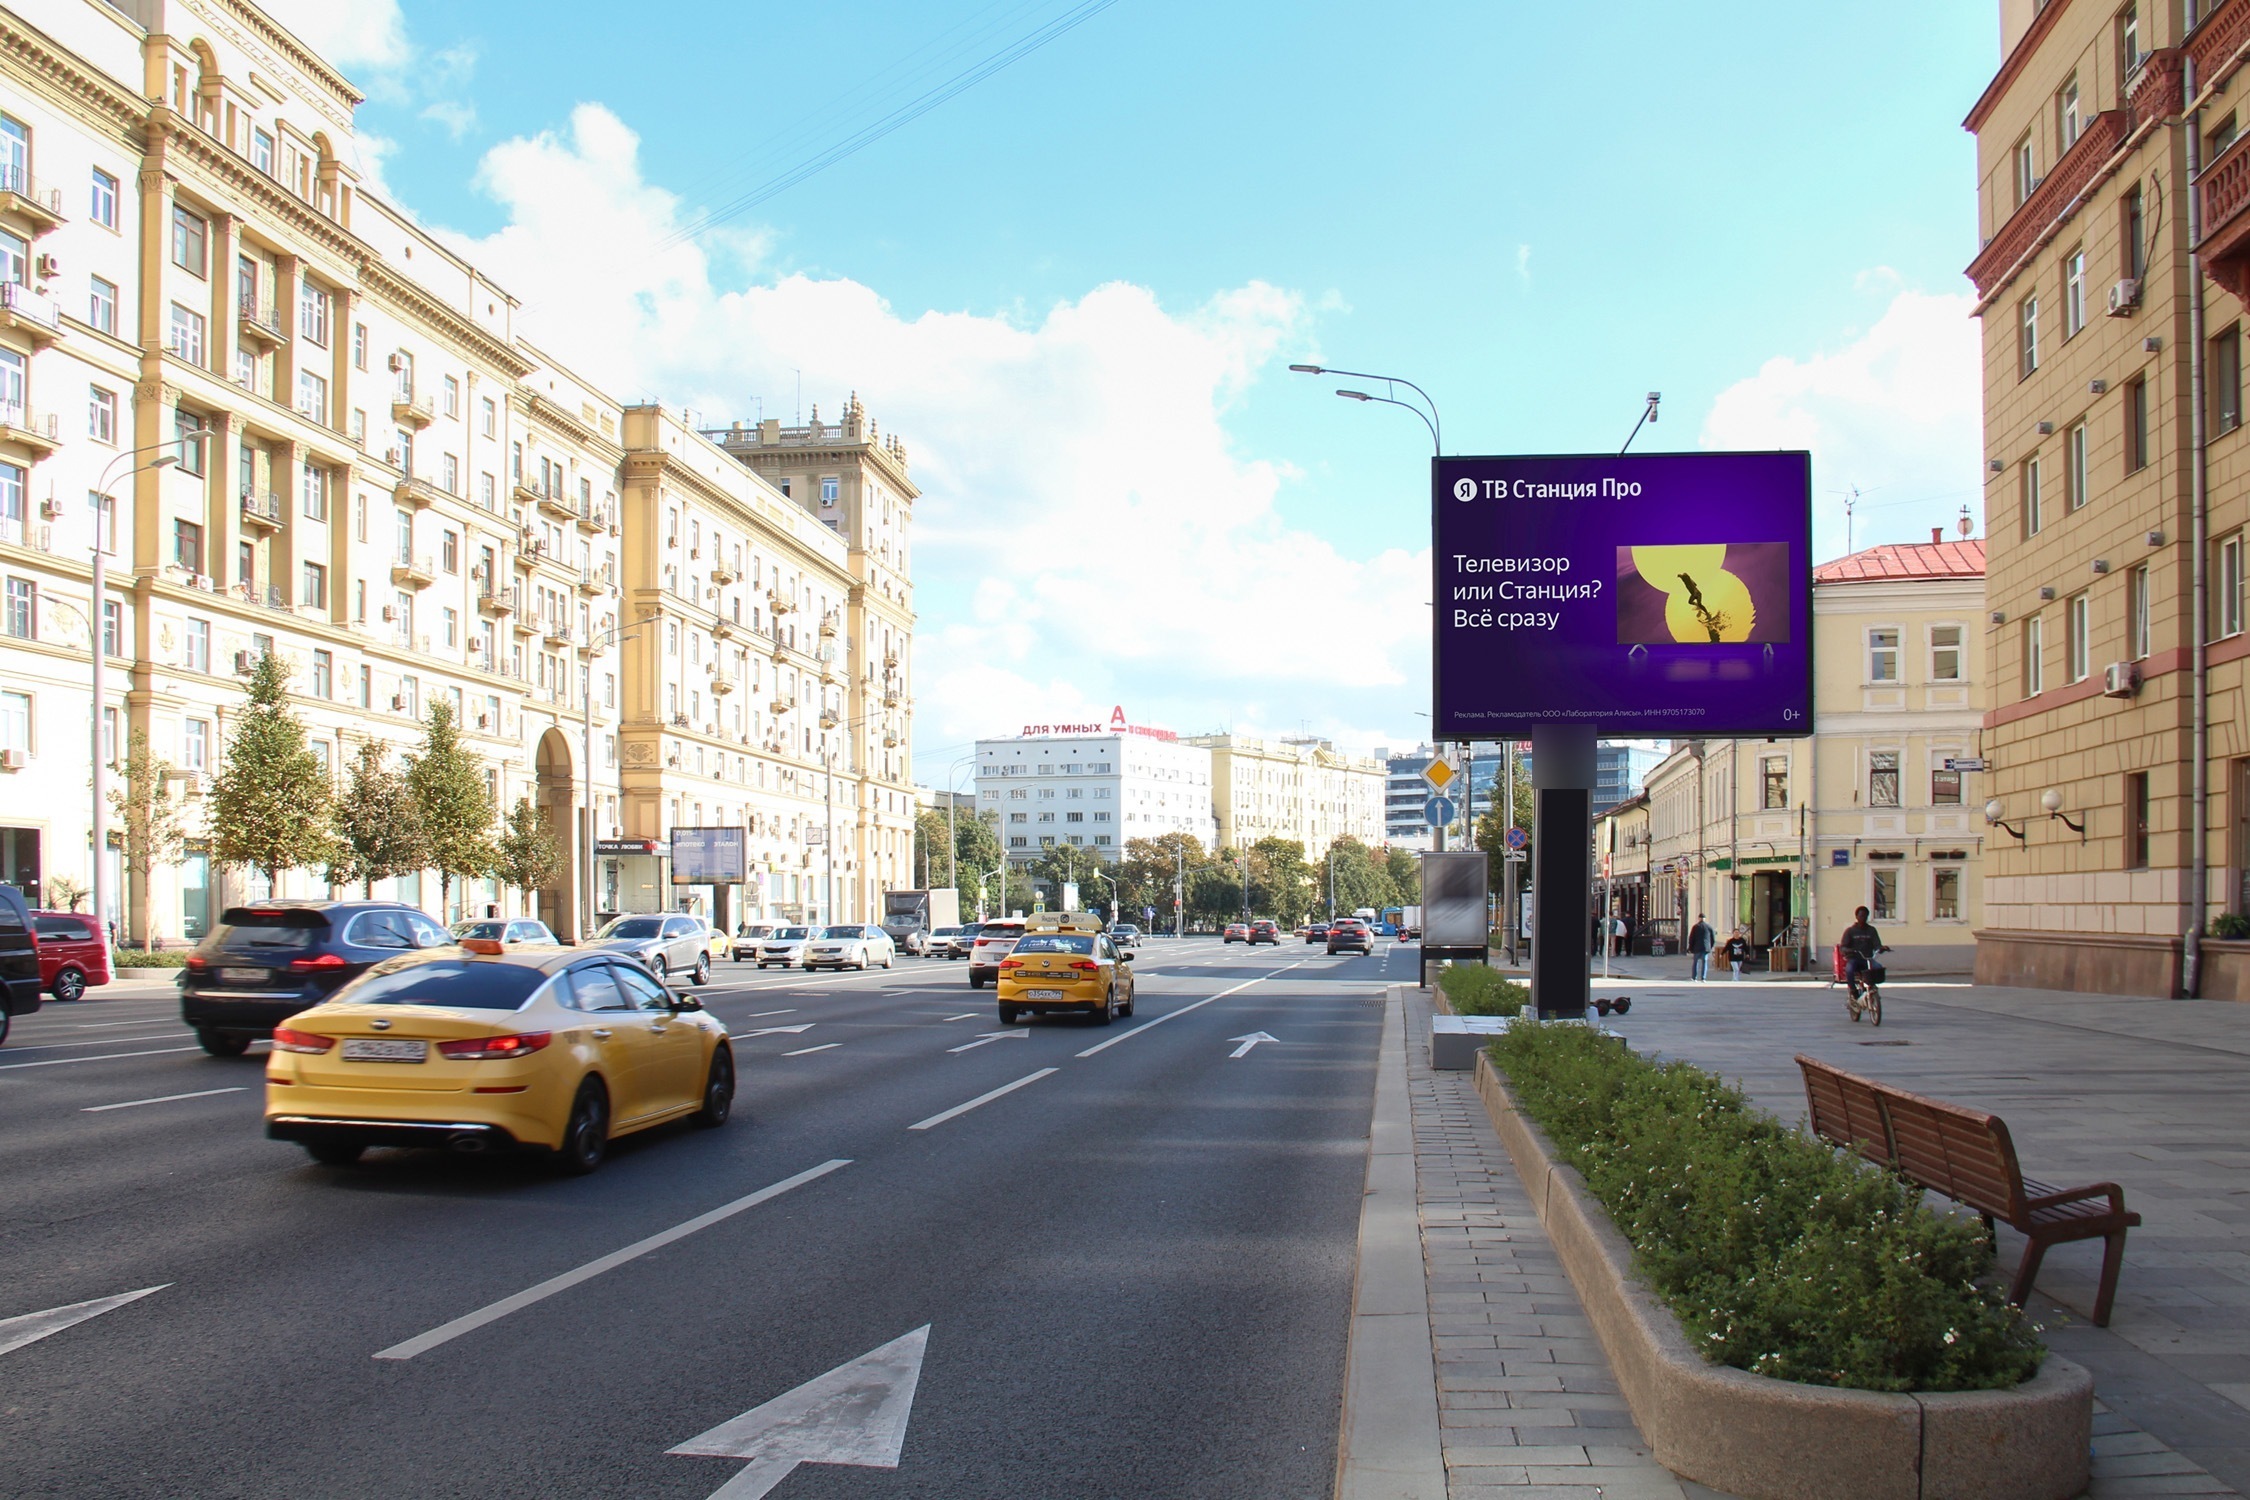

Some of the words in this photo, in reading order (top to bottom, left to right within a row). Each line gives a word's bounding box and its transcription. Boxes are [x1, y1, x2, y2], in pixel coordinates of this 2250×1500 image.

[1482, 479, 1508, 499] ТВ
[1512, 479, 1597, 500] Станция
[1602, 477, 1642, 500] Про
[1453, 554, 1570, 576] Телевизор
[1453, 585, 1494, 601] или
[1498, 579, 1603, 602] Станция?
[1454, 608, 1493, 628] Всё
[1497, 611, 1560, 631] сразу
[1454, 711, 1486, 719] Реклама.
[1487, 710, 1542, 719] Рекламодатель
[1542, 710, 1561, 718] ООО
[1561, 709, 1613, 718] «Лаборатория
[1614, 709, 1643, 717] Алисы».
[1644, 709, 1661, 717] ИНН
[1662, 708, 1705, 716] 9705173070
[1783, 708, 1800, 721] 0+
[1022, 725, 1049, 736] ДЛЯ
[1053, 724, 1102, 733] УМНЫХ
